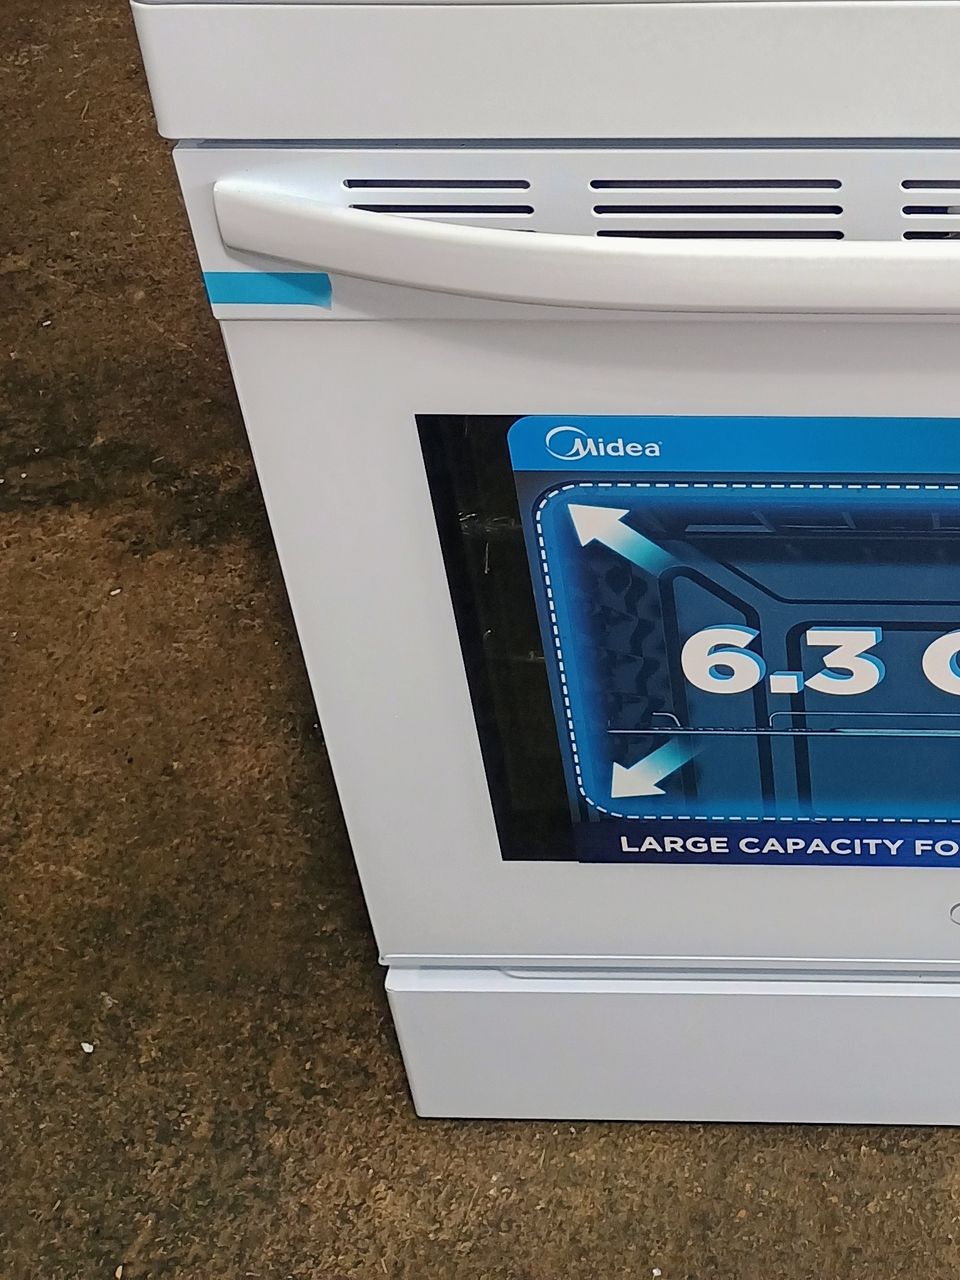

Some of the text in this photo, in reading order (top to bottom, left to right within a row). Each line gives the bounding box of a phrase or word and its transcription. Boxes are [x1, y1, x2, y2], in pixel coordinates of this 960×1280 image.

[545, 426, 662, 461] Midea
[681, 625, 885, 695] 6.3
[620, 836, 730, 854] LARGE
[738, 837, 905, 856] CAPACITY
